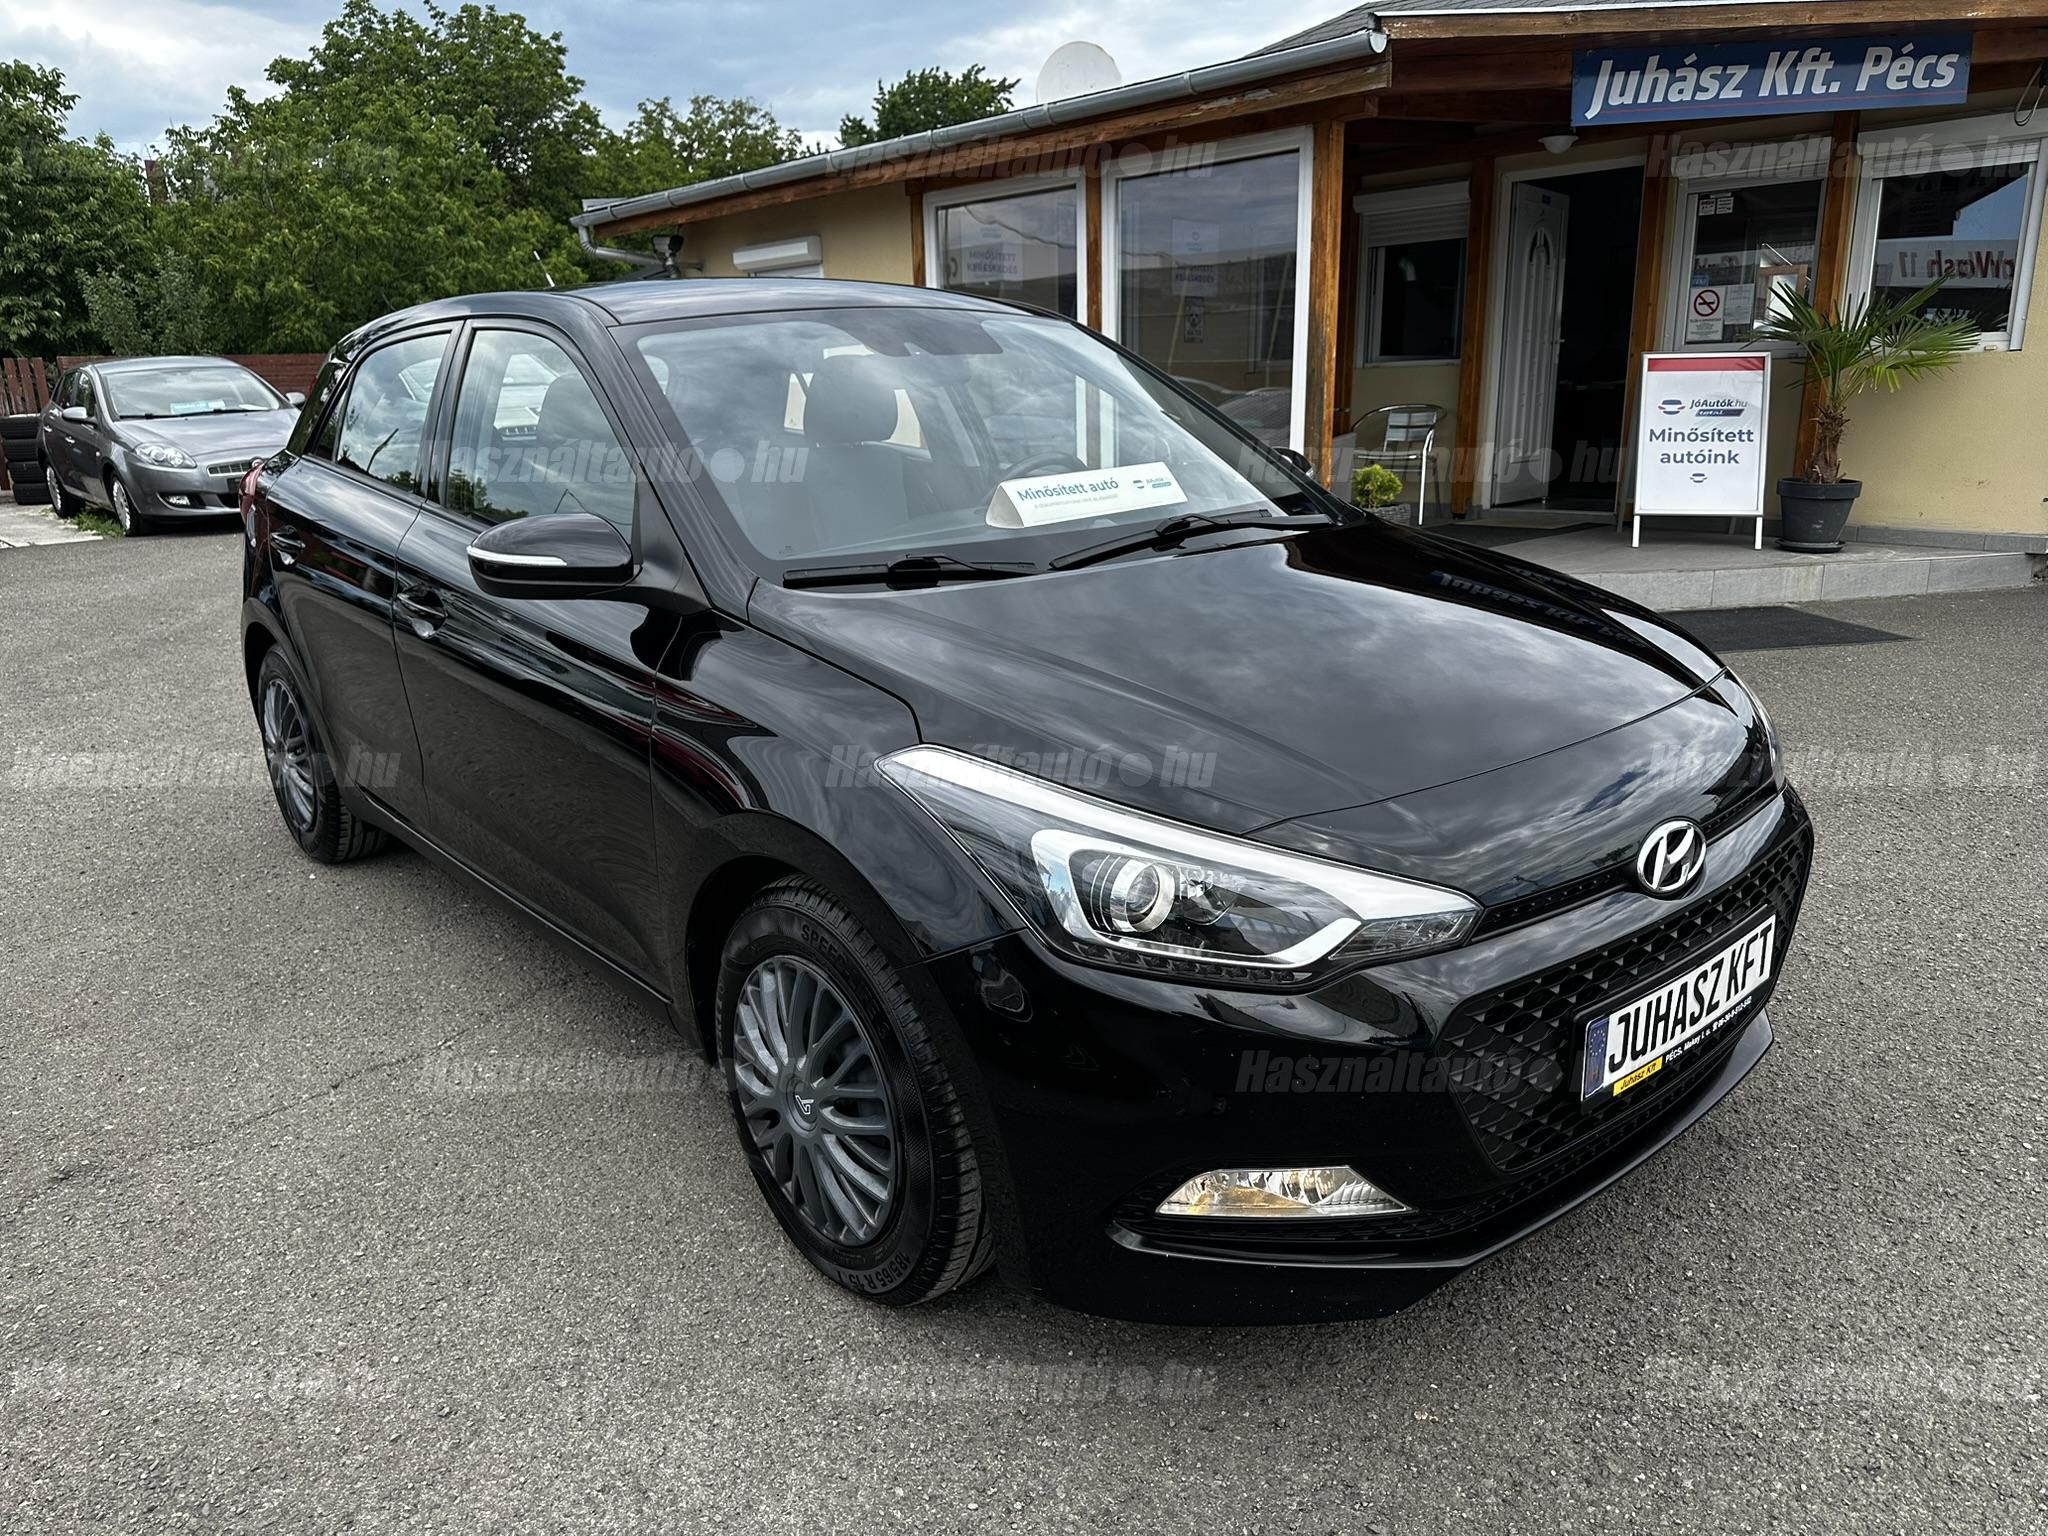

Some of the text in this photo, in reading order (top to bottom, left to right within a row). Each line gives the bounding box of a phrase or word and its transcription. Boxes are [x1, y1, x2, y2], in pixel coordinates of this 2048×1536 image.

[1584, 42, 1959, 120] Juhász Kft. Pécs
[1649, 426, 1754, 443] Minősített
[1660, 448, 1740, 465] autóink
[1017, 479, 1087, 502] Minősített
[1090, 476, 1119, 492] autó
[1608, 923, 1773, 1074] JUHASZ KFT
